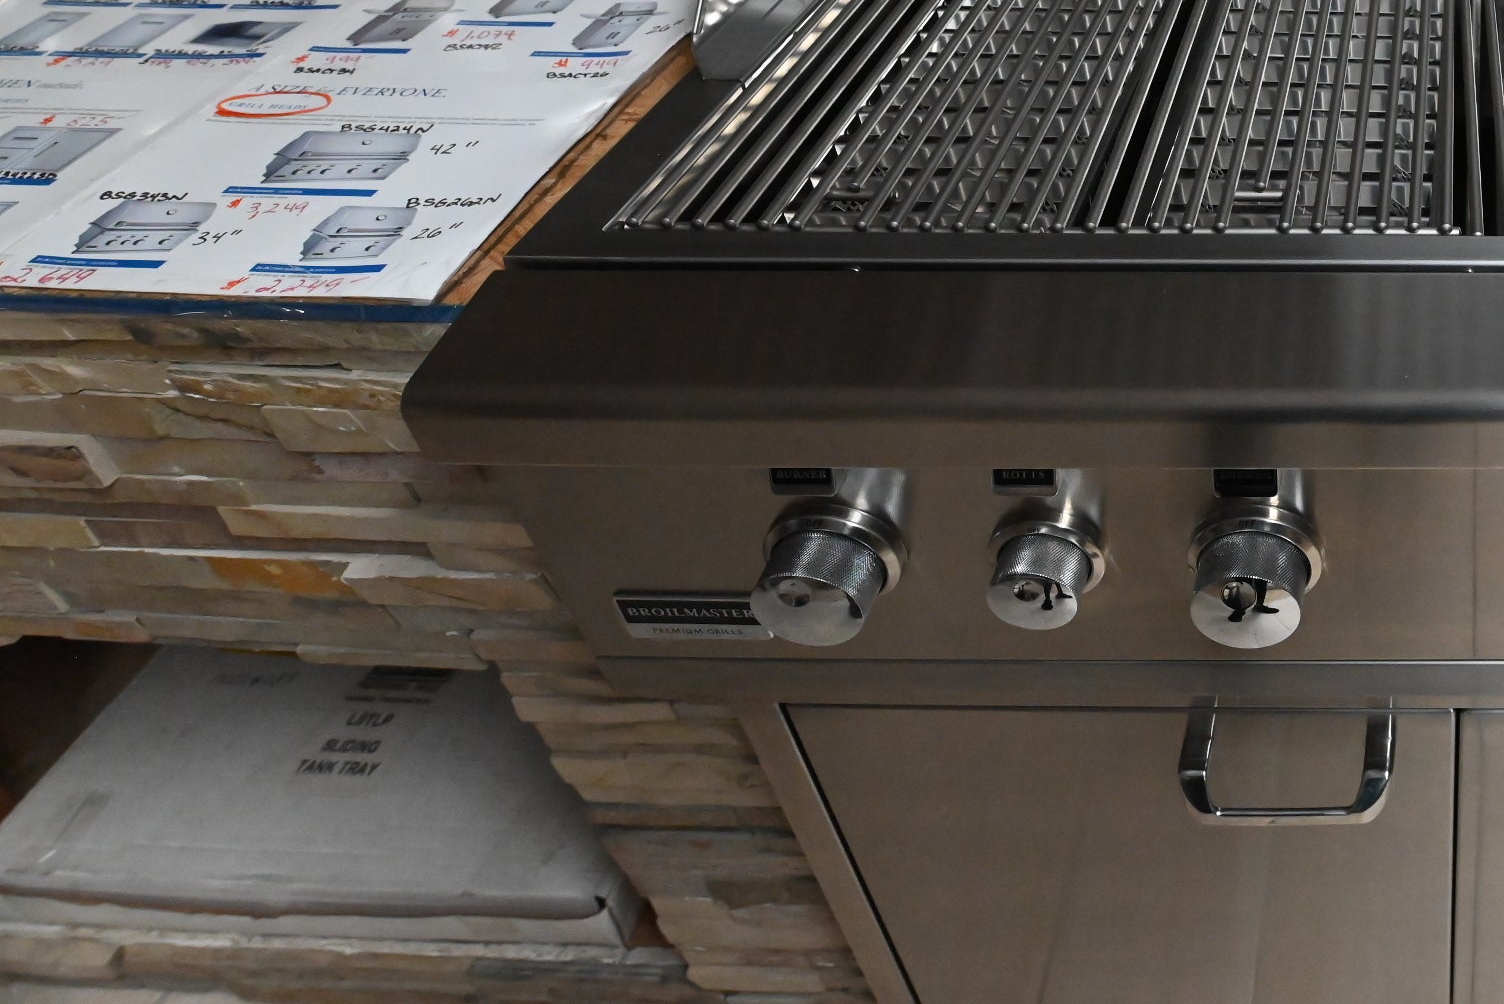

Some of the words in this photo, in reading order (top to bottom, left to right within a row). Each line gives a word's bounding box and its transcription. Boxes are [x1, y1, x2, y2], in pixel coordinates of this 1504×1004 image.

[340, 122, 435, 134] BSG424N
[99, 189, 189, 202] BSG343N
[405, 192, 503, 210] BSG262N
[627, 607, 756, 619] BROILMASTER
[652, 627, 703, 636] PREMIUM
[706, 628, 744, 636] GRILLS
[319, 737, 383, 754] SLIDING
[295, 758, 339, 775] TANK
[338, 760, 383, 777] TRAY
